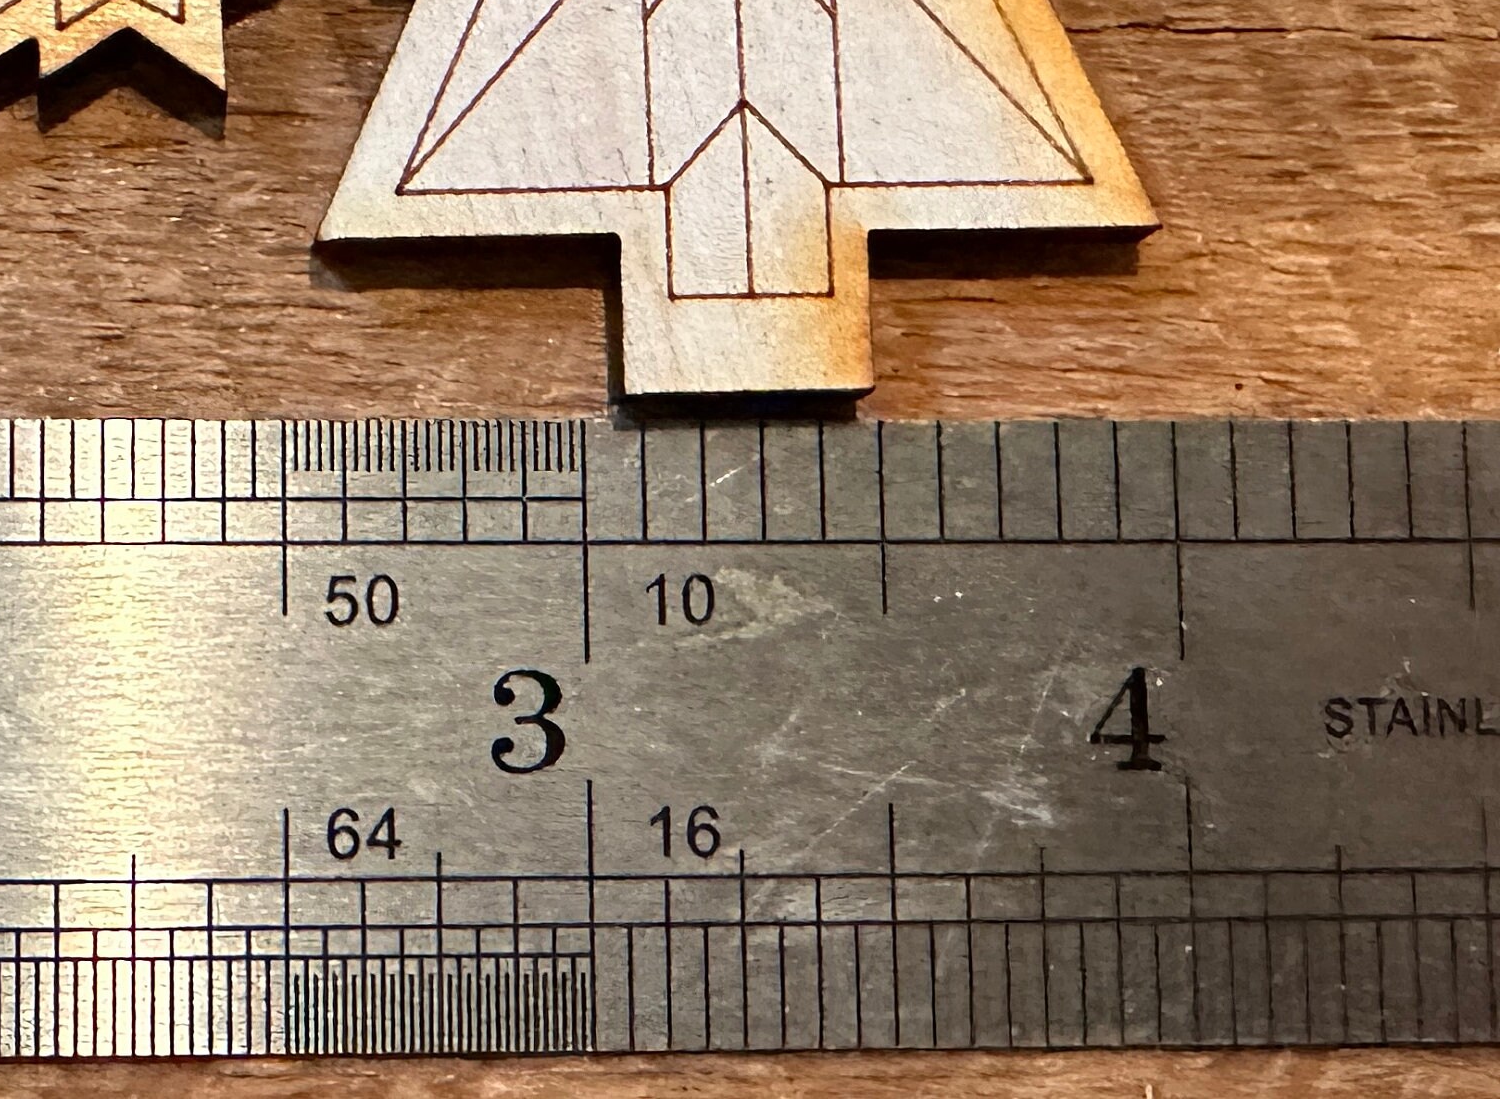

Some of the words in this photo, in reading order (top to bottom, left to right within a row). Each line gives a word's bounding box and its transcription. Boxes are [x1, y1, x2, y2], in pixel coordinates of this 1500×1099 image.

[325, 574, 400, 627] 50
[645, 573, 716, 627] 10
[492, 668, 566, 775] 3
[1089, 666, 1166, 772] 4
[1323, 696, 1500, 739] STAINL
[325, 807, 402, 861] 64
[648, 804, 721, 859] 16
